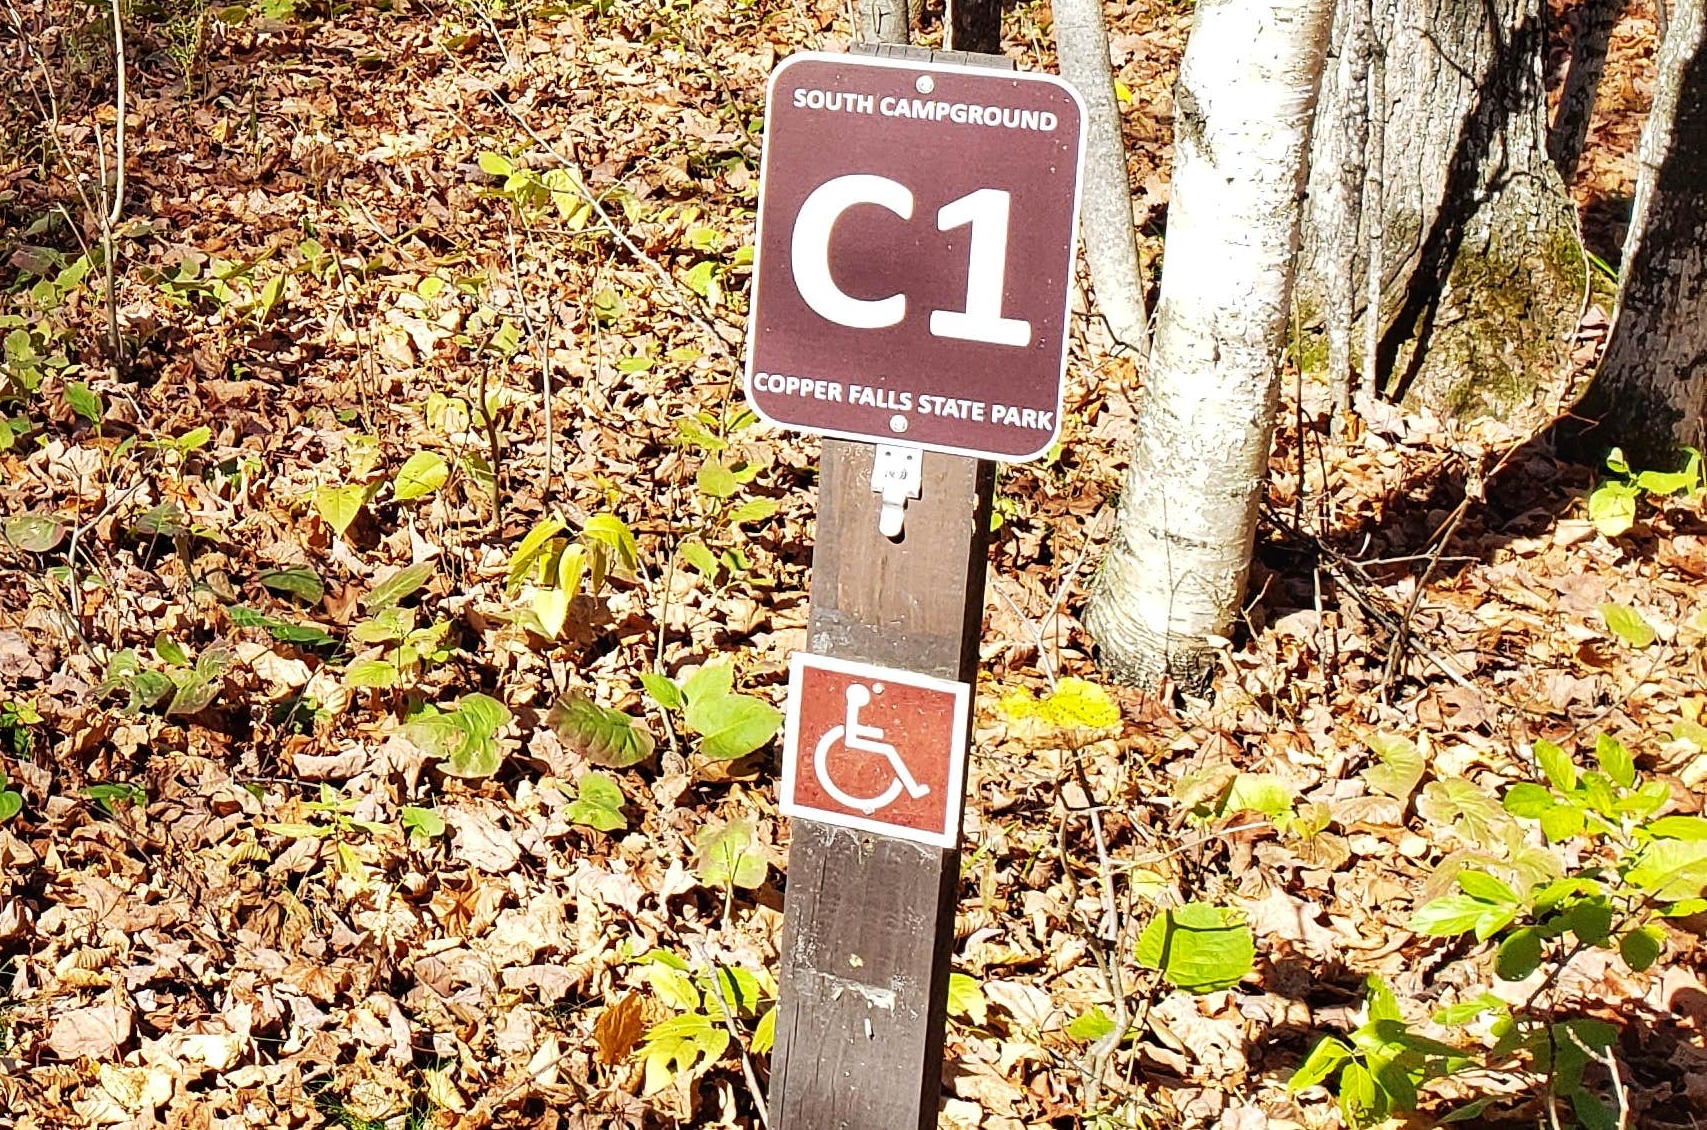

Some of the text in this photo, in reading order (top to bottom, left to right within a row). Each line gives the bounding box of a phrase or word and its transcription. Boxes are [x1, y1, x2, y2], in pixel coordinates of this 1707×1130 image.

[794, 89, 1058, 132] SOUTH CAMPGROUND
[791, 174, 1032, 347] C1
[754, 372, 1054, 431] COPPER FALLS STATE PARK
